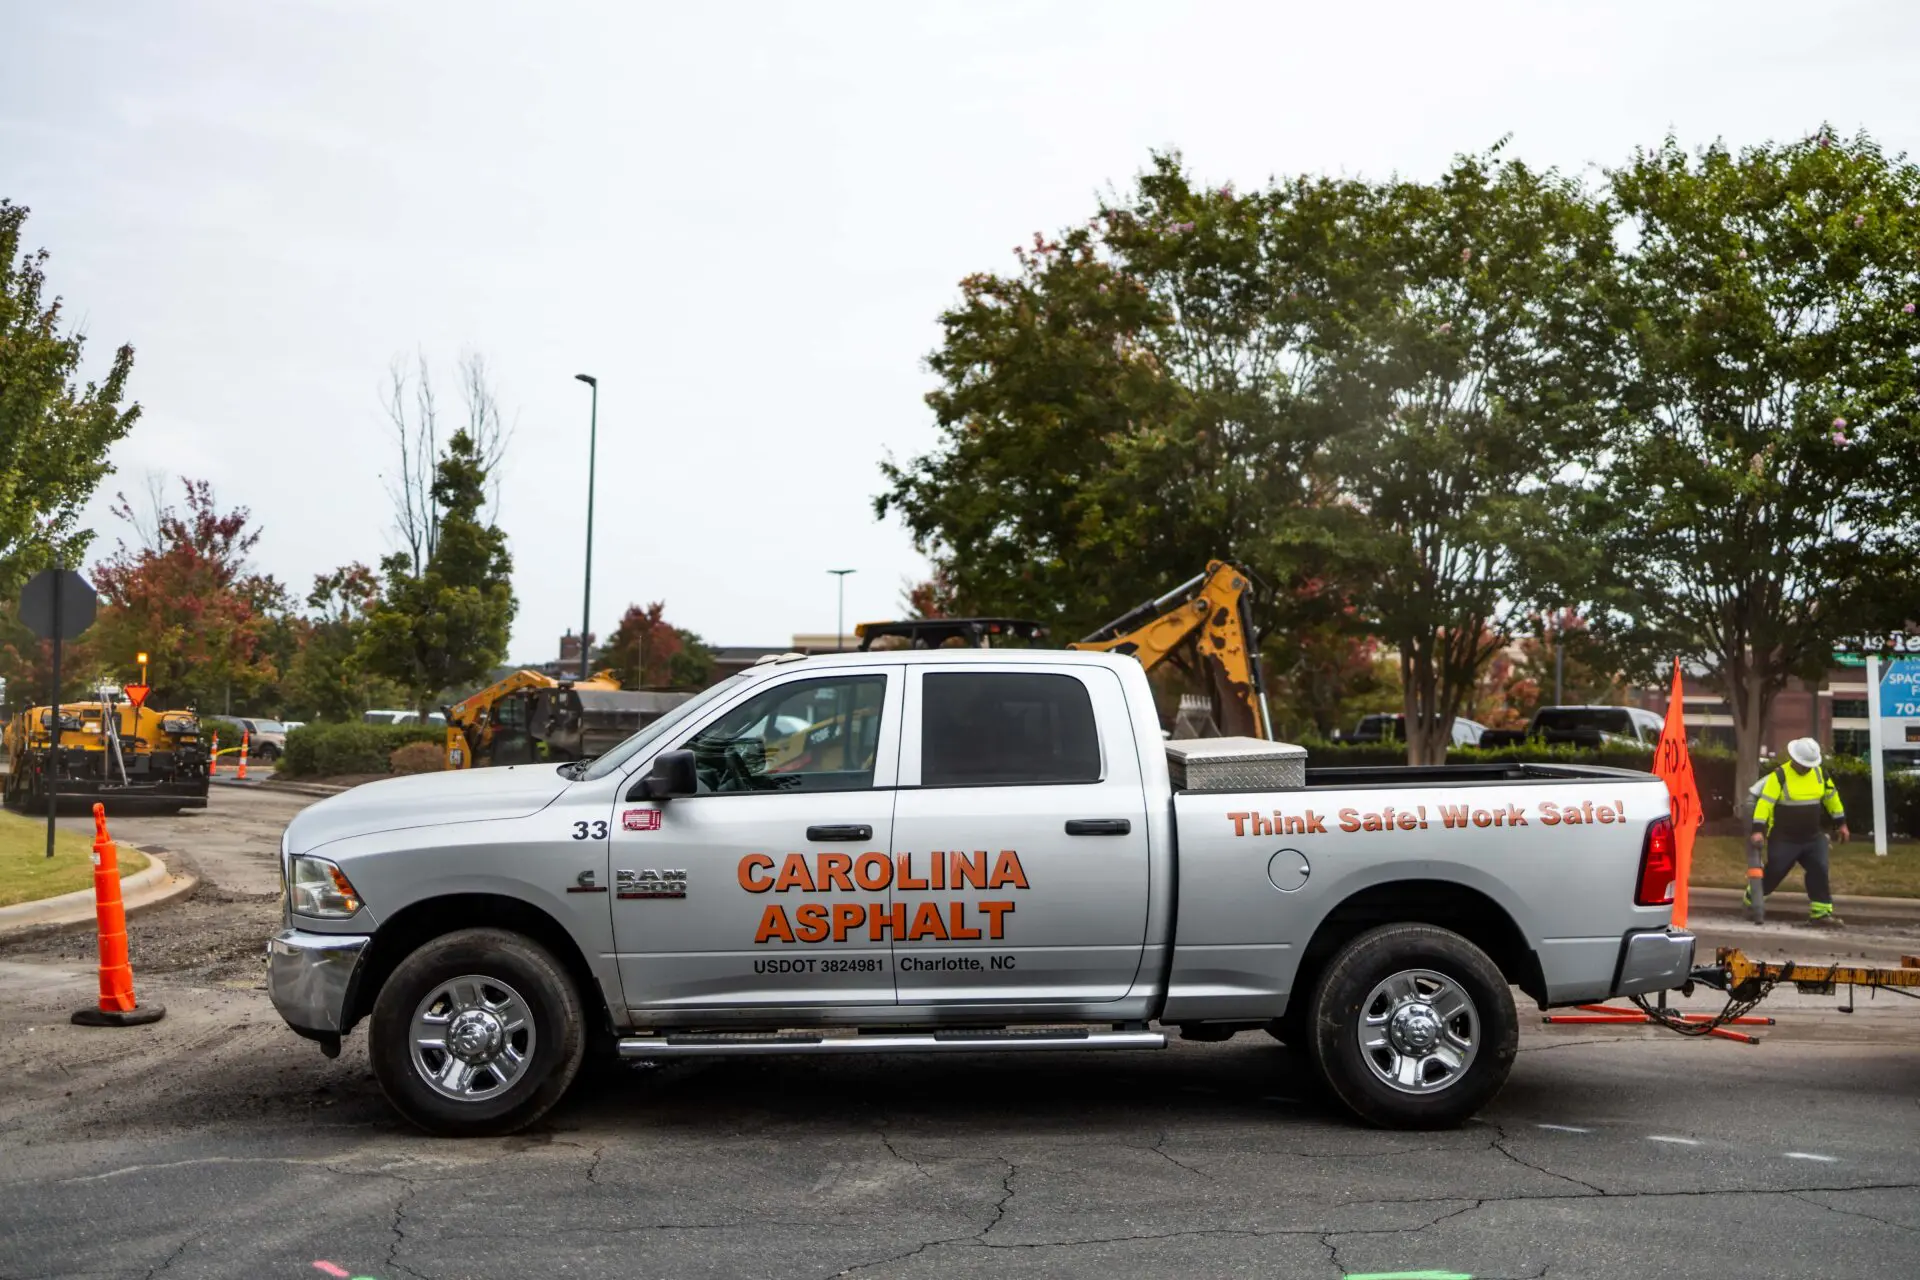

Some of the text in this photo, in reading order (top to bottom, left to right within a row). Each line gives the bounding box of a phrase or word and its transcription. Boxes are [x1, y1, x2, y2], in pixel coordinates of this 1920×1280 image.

[1227, 800, 1627, 837] Think Safe! Work Safe!
[572, 820, 608, 840] 33
[616, 868, 687, 881] RAM
[737, 850, 1030, 893] CAROLINA
[616, 880, 687, 893] 2500
[754, 901, 1015, 944] ASPHALT
[754, 955, 1016, 973] USDOT 3824981 Charlotte, NC
